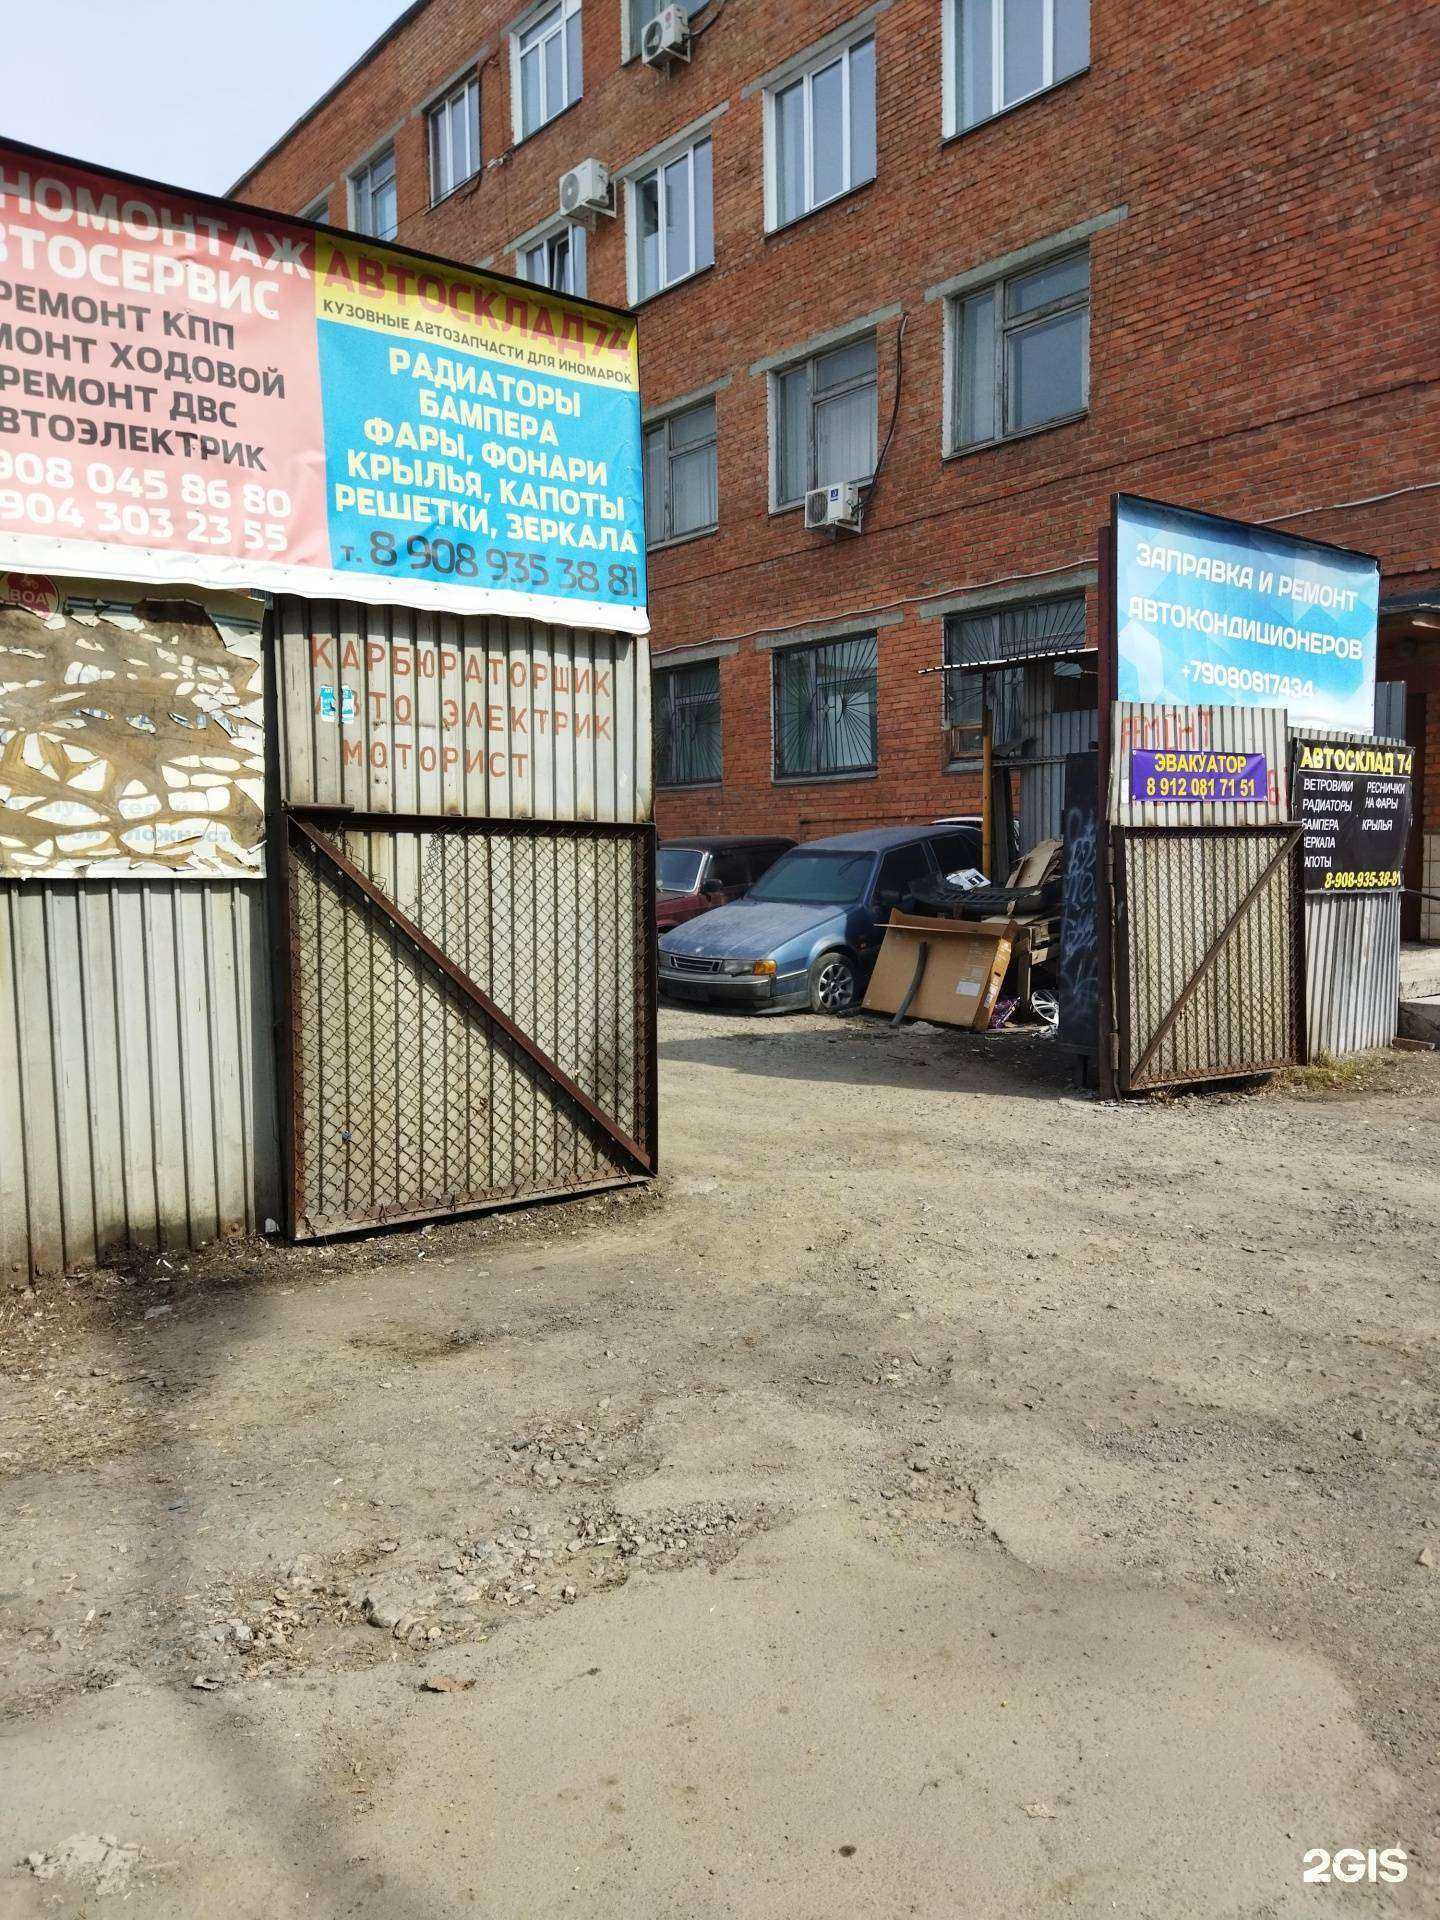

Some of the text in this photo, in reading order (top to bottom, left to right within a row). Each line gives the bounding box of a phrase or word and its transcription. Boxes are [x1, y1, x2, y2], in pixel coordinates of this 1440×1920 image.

[163, 310, 234, 350] КПП
[323, 299, 632, 384] КУЗОВНЫЕ АВТОЗАПЧАСТИ ДЛЯ ИНОМАРОК
[110, 342, 286, 399] ХОДОВОЙ
[389, 347, 581, 417] РАДИАТОРЫ
[0, 364, 237, 428] РЕМОНТ ДВС
[419, 389, 559, 446] БАМПЕРА
[0, 406, 267, 472] ВТОЭЛЕКТРИК
[364, 417, 608, 487] ФАРЫ, ФОНАРИ
[86, 461, 169, 499] 045
[180, 473, 231, 510] 86
[243, 483, 292, 517] 80
[347, 448, 625, 522] КРЫЛЬЯ, КАПОТЫ
[95, 501, 174, 539] 303
[186, 510, 232, 545] 23
[244, 518, 288, 551] 55
[335, 483, 638, 554] РЕШЕТКИ, ЗЕРКАЛА
[370, 530, 398, 567] 8
[407, 535, 479, 577] 908
[485, 548, 549, 586] 935
[555, 557, 600, 593] 38
[607, 563, 638, 599] 81
[1136, 542, 1359, 611] ЗАПРАВКА И РЕМОНТ
[1128, 596, 1363, 660] АВТОКОНДИЦИОНЕРОВ
[1181, 660, 1315, 699] +79080817434
[442, 699, 612, 741] ЭЛЕКТРИК
[343, 739, 529, 778] МОТОРИСТ
[1154, 752, 1247, 774] ЭВАКУАТОР
[1301, 747, 1412, 776] АВТОСКЛАД 74
[1146, 777, 1156, 795] 8
[1160, 777, 1187, 796] 912
[1191, 778, 1215, 796] 081
[1219, 778, 1235, 796] 71
[1240, 779, 1255, 796] 51
[1303, 778, 1353, 792] ВЕТРОВИКИ
[1303, 799, 1353, 813] РАДИАТОРЫ
[1365, 798, 1399, 809] НА ФАРЫ
[1367, 781, 1406, 795] РЕСНИЧКИ
[1304, 836, 1336, 848] ЕРКАЛА
[1362, 820, 1393, 831] КРЫЛЬЯ
[1304, 856, 1332, 868] АПОТЫ
[1324, 870, 1401, 889] 8-908-935-38-81
